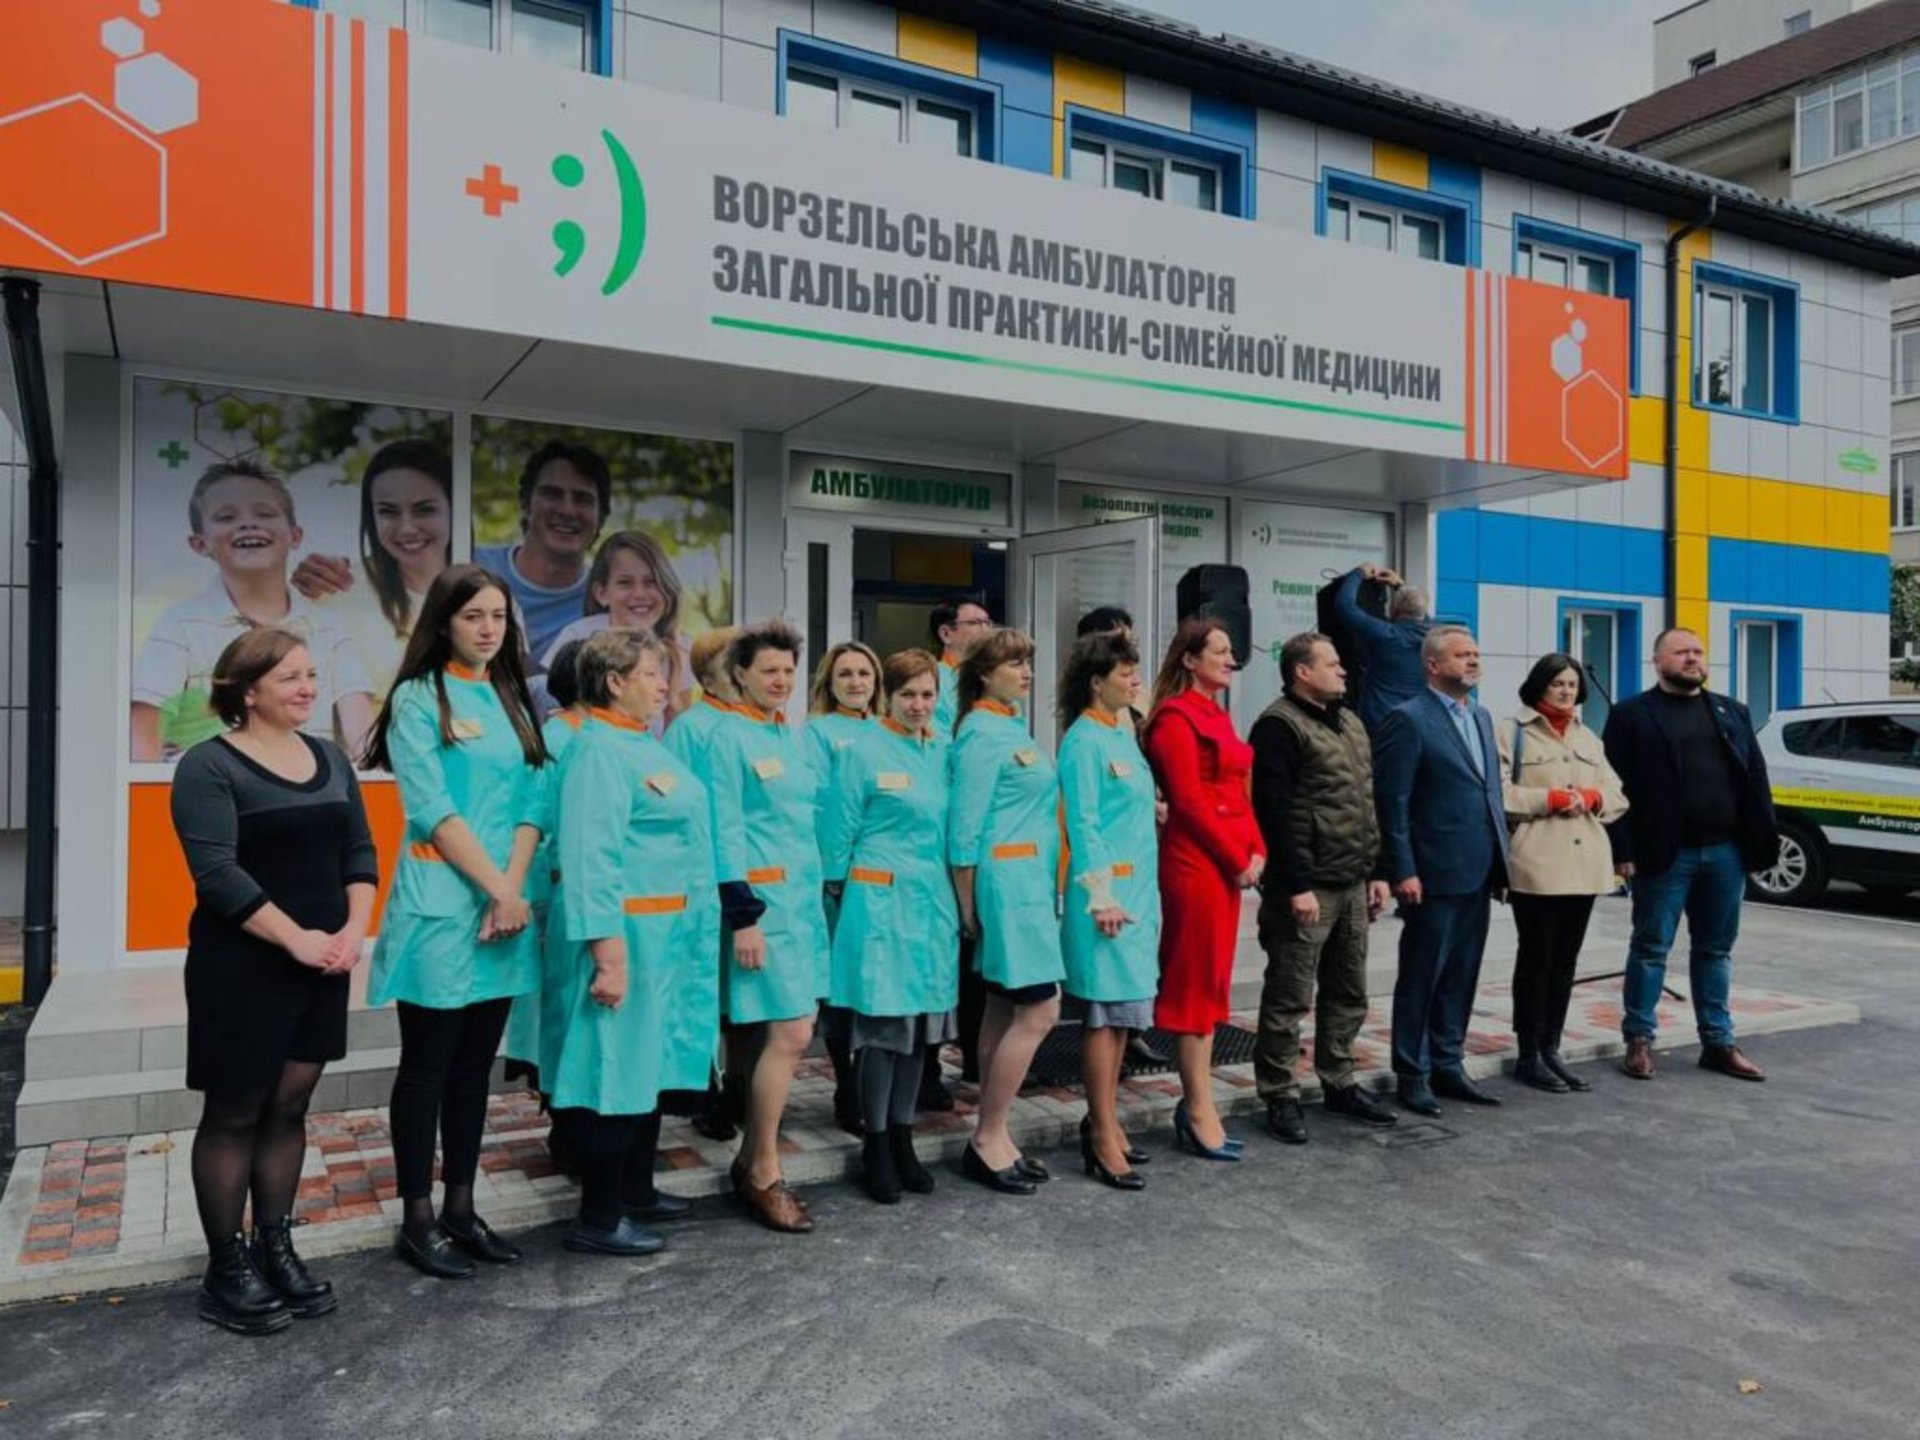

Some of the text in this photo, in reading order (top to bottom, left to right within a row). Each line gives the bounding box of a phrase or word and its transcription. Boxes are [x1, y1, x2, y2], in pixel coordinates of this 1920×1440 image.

[713, 175, 1236, 314] ВОРЗЕЛЬСЬКА АМБУЛАТОРІЯ
[713, 244, 1441, 402] ЗАГАЛЬНОЇ ПРАКТИКИ-СІМЕЙНОЇ МЕДИЦИНИ
[811, 468, 991, 511] АМБУЛАТОРІЯ
